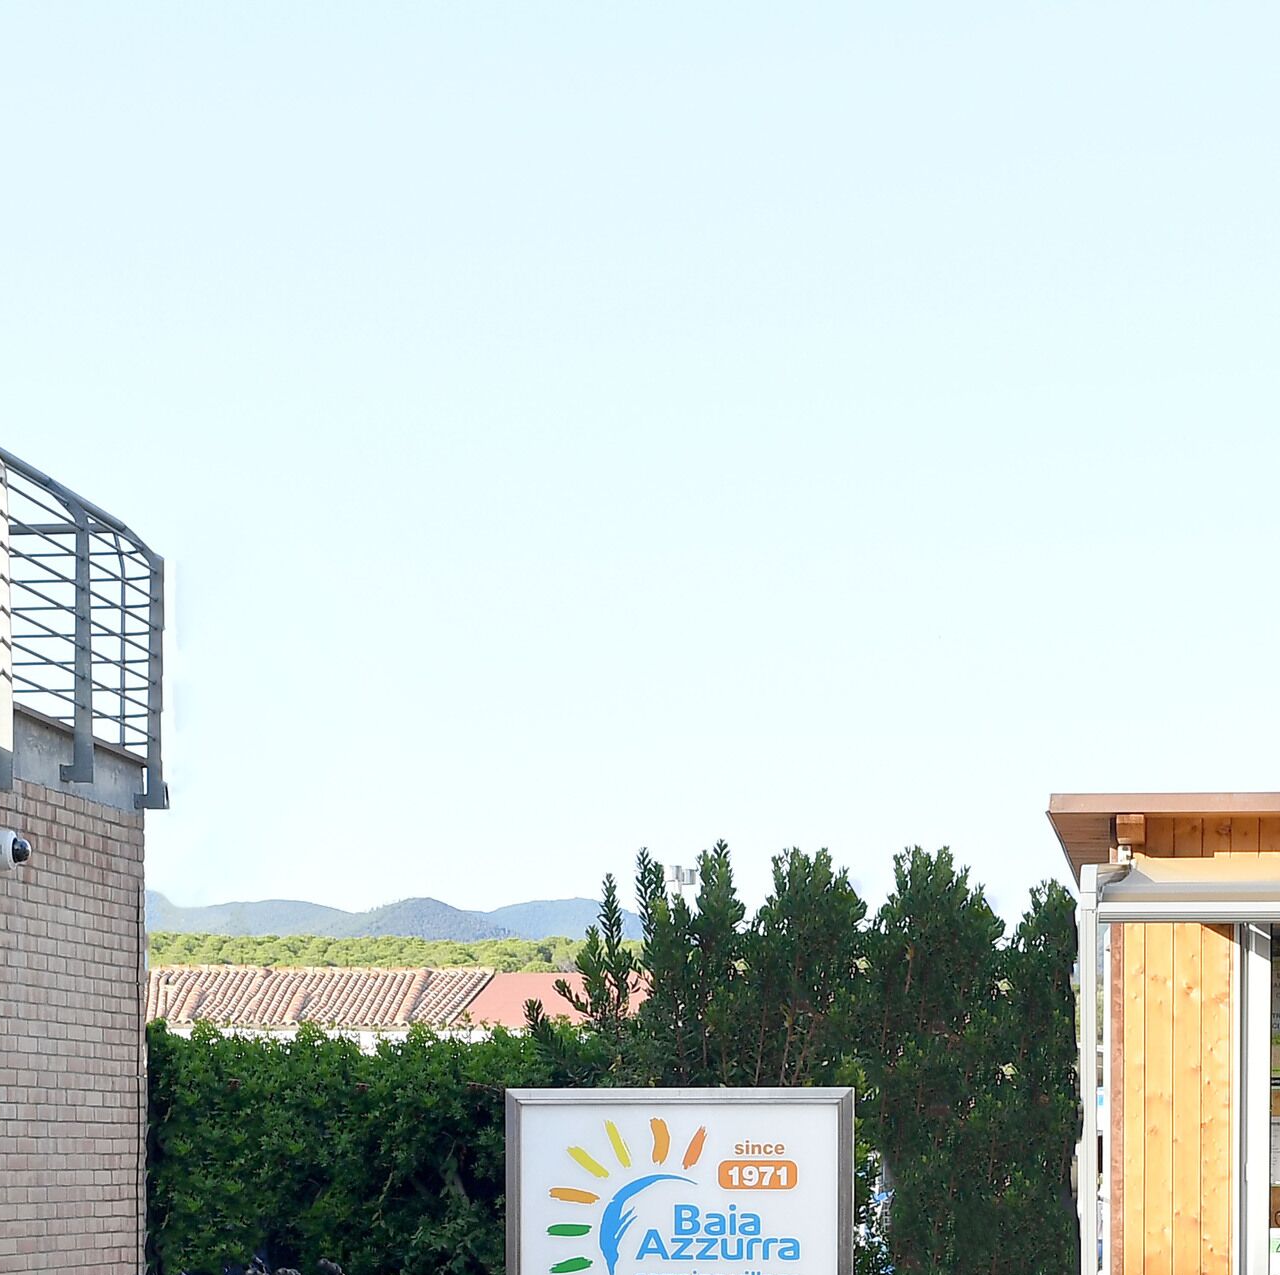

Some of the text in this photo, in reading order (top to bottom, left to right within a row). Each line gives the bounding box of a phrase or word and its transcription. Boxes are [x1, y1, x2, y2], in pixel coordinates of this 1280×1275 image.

[734, 1140, 785, 1155] since
[727, 1165, 789, 1187] 1971
[673, 1204, 761, 1236] Baia
[635, 1229, 801, 1261] Azzurra
